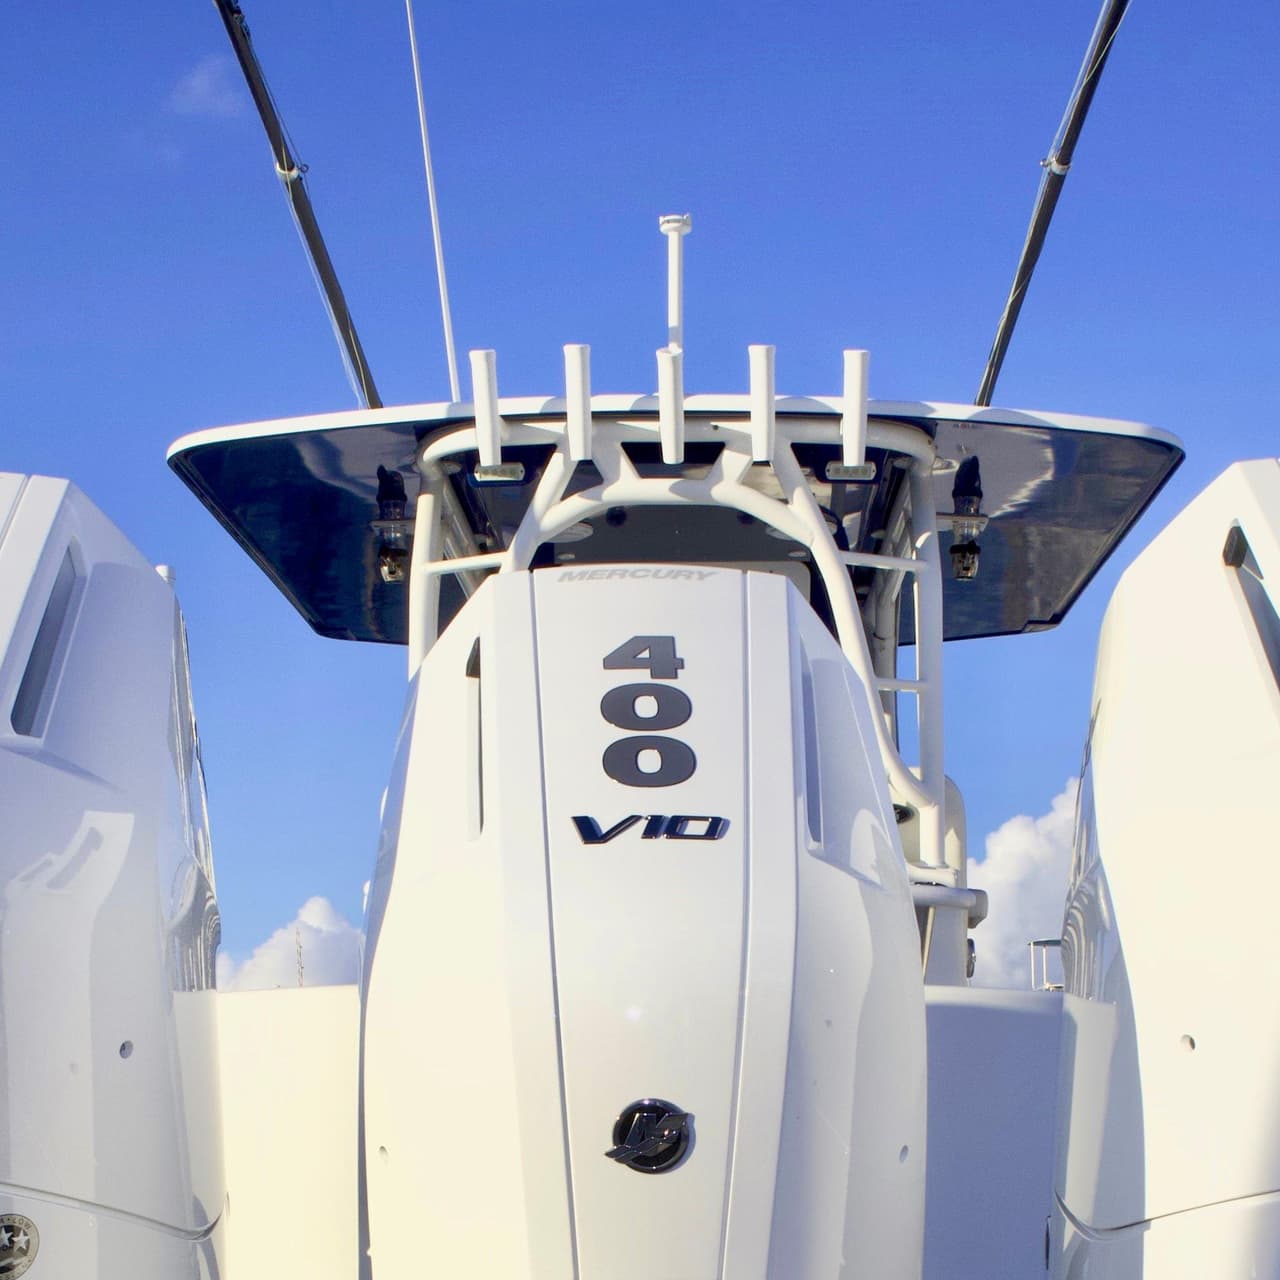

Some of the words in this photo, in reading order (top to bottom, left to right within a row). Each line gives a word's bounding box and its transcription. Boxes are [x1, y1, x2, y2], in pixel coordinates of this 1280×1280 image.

[558, 568, 717, 582] MERCURY
[600, 636, 697, 788] 400
[571, 815, 726, 844] V10
